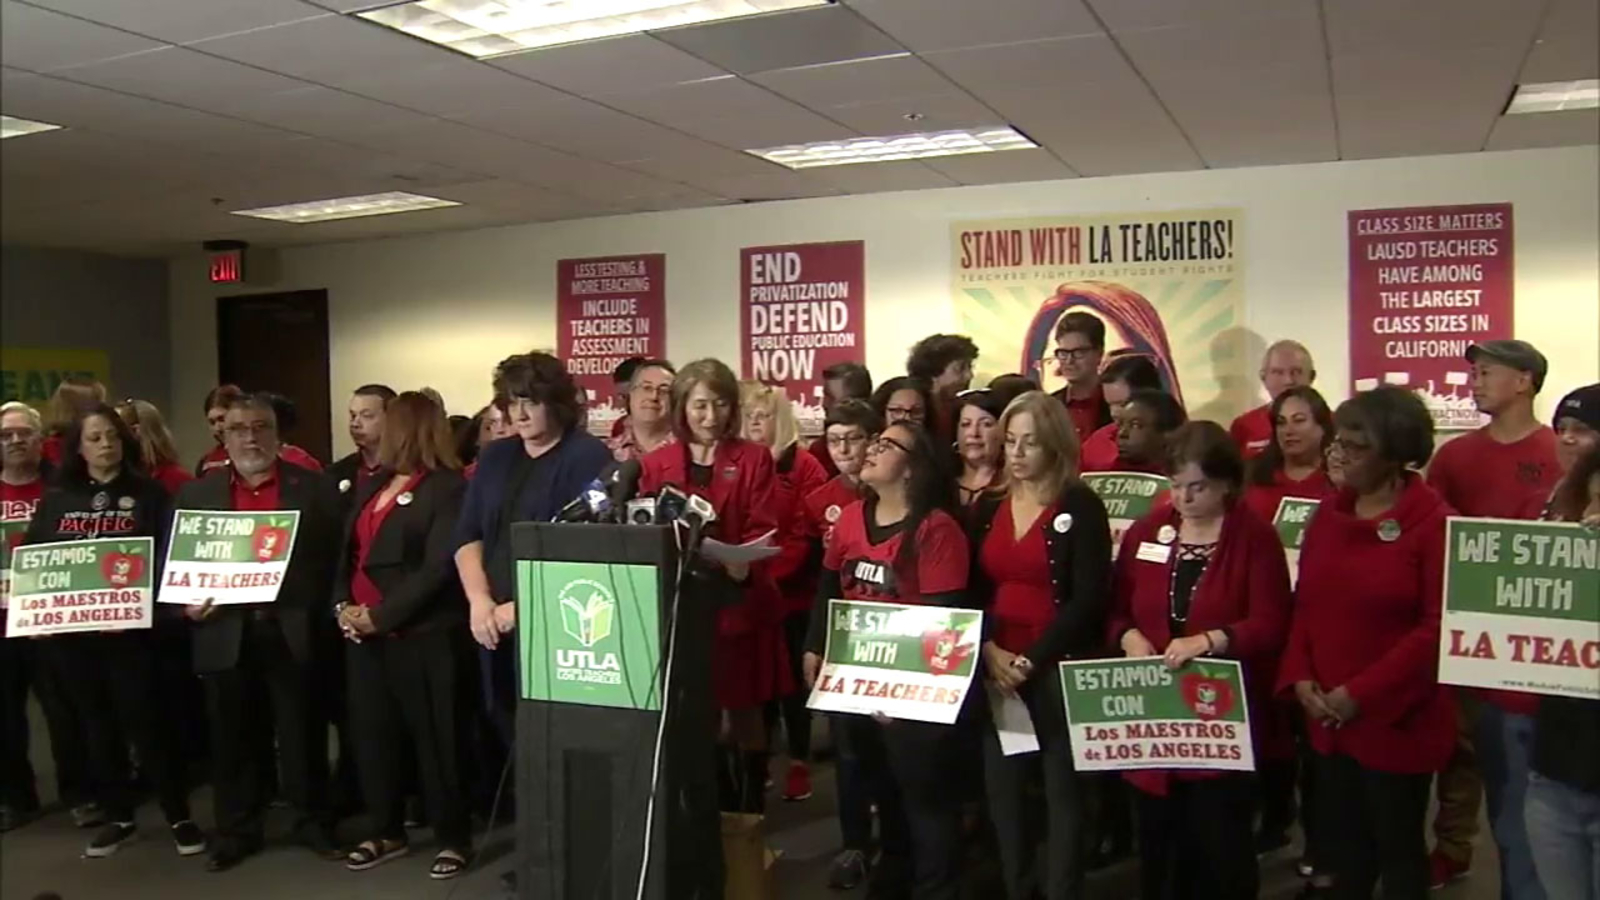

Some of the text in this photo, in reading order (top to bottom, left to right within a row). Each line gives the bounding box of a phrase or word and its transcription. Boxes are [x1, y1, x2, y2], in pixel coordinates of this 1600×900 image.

[1357, 212, 1503, 233] CLASS SIZE MATTERS
[961, 219, 1233, 269] STAND WITH LA TEACHERS!
[1367, 238, 1498, 261] LAUSD TEACHERS
[574, 262, 597, 278] LESS
[598, 261, 636, 277] TESTING
[751, 252, 801, 285] END
[1379, 264, 1483, 284] HAVE AMONG
[571, 277, 650, 294] MORE TEACHING
[751, 281, 848, 302] PRIVATIZATION
[583, 298, 637, 316] INCLUDE
[1380, 289, 1482, 309] THE LARGEST
[570, 317, 650, 336] TEACHERS IN
[751, 300, 848, 335] DEFEND
[1373, 313, 1489, 333] CLASS SIZES IN
[571, 337, 650, 355] ASSESSMENT
[752, 332, 855, 350] PUBLIC EDUCATION
[1385, 340, 1476, 358] CALIFORNI
[567, 356, 655, 374] DEVELOP
[752, 349, 815, 381] NOW
[1104, 478, 1158, 497] STAND
[1283, 504, 1311, 522] WE
[178, 515, 255, 536] WE STAND
[21, 547, 97, 570] ESTAMOS
[194, 540, 233, 559] WITH
[1459, 531, 1599, 570] WE STAN
[39, 571, 71, 590] CON
[165, 570, 282, 589] LA TEACHERS
[855, 561, 885, 584] UTLA
[51, 590, 142, 608] MAESTROS
[1496, 576, 1573, 611] WITH
[33, 611, 64, 626] LOS
[68, 606, 144, 623] ANGELES
[835, 608, 862, 632] WE
[853, 639, 898, 665] WITH
[1448, 629, 1498, 660] LA
[557, 649, 621, 671] UTLA
[1074, 664, 1173, 691] ESTAMOS
[819, 674, 963, 705] LA TEACHERS
[1102, 694, 1144, 717] CON
[1085, 722, 1236, 741] Los MAESTROS
[1085, 742, 1242, 761] de LOS ANGELES
